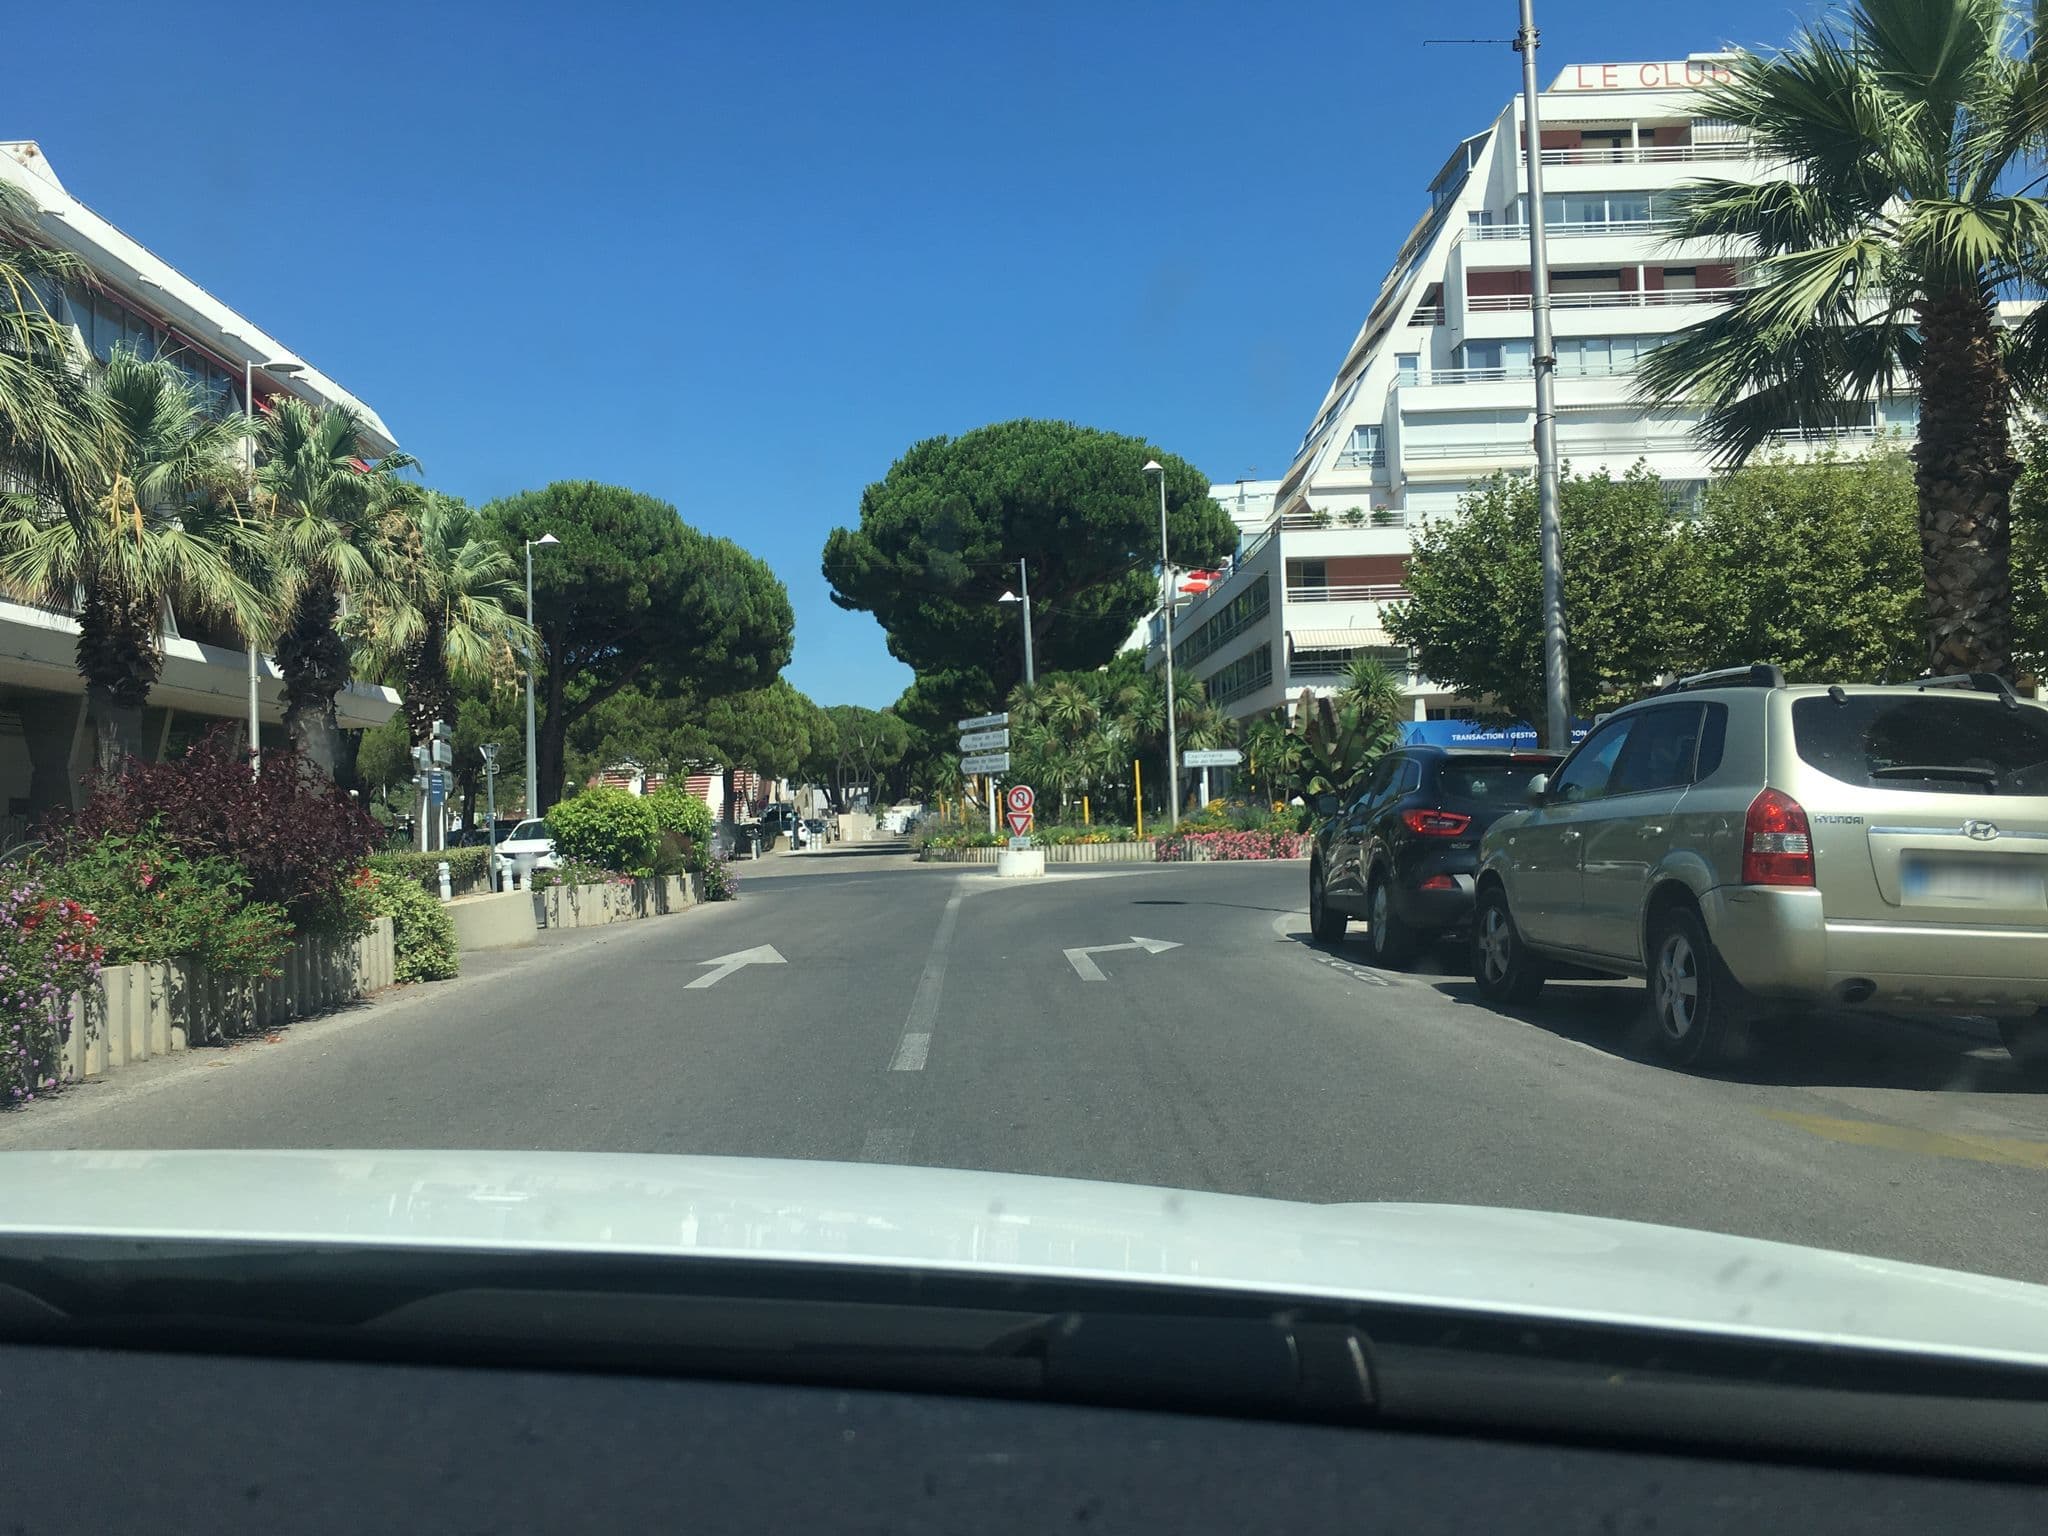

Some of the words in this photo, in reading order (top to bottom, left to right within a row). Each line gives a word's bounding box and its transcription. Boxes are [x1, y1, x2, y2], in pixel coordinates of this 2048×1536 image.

[1577, 65, 1618, 88] LE
[1639, 62, 1731, 87] CLUB
[1452, 732, 1504, 741] TRANSACTION
[1510, 731, 1538, 739] GESTIO
[1814, 815, 1864, 825] HYUNDAI
